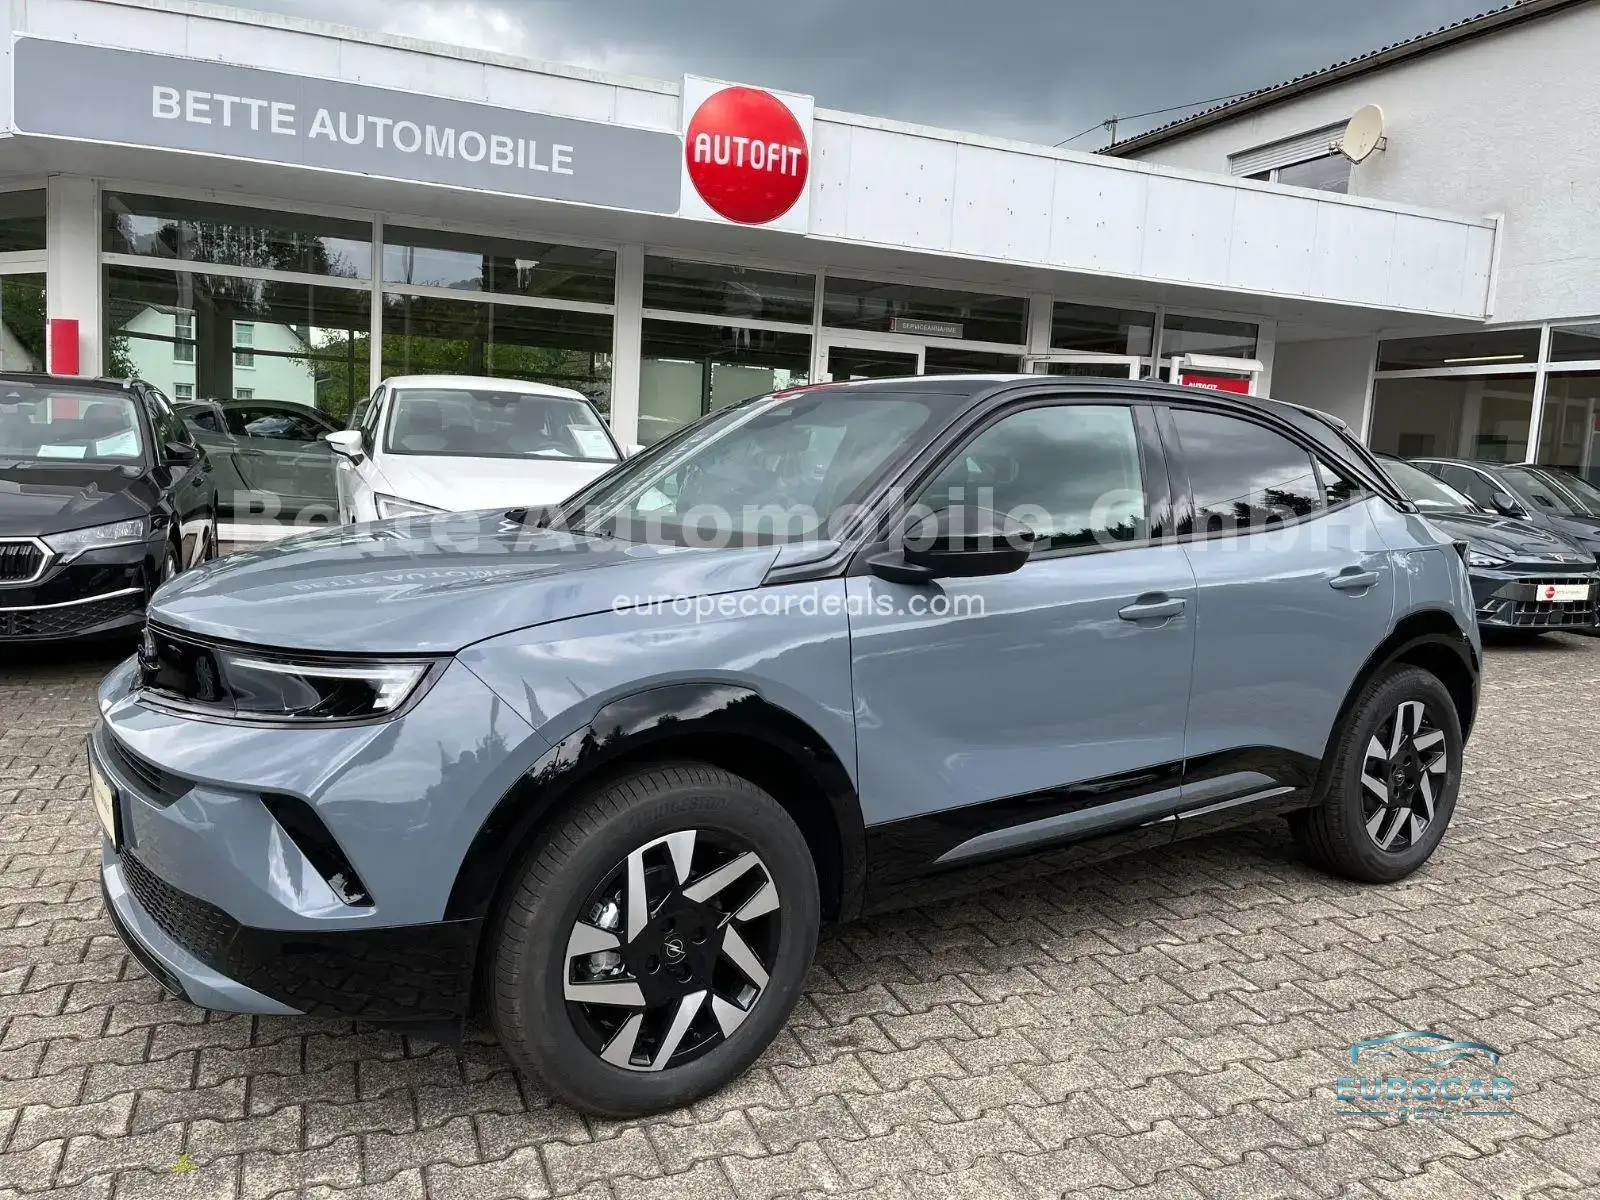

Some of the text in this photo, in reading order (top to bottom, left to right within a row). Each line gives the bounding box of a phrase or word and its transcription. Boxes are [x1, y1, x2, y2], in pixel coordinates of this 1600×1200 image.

[152, 85, 574, 175] BETTE AUTOMOBILE
[694, 132, 802, 176] AUTOFIT
[902, 322, 957, 334] SERVICEANNAHME
